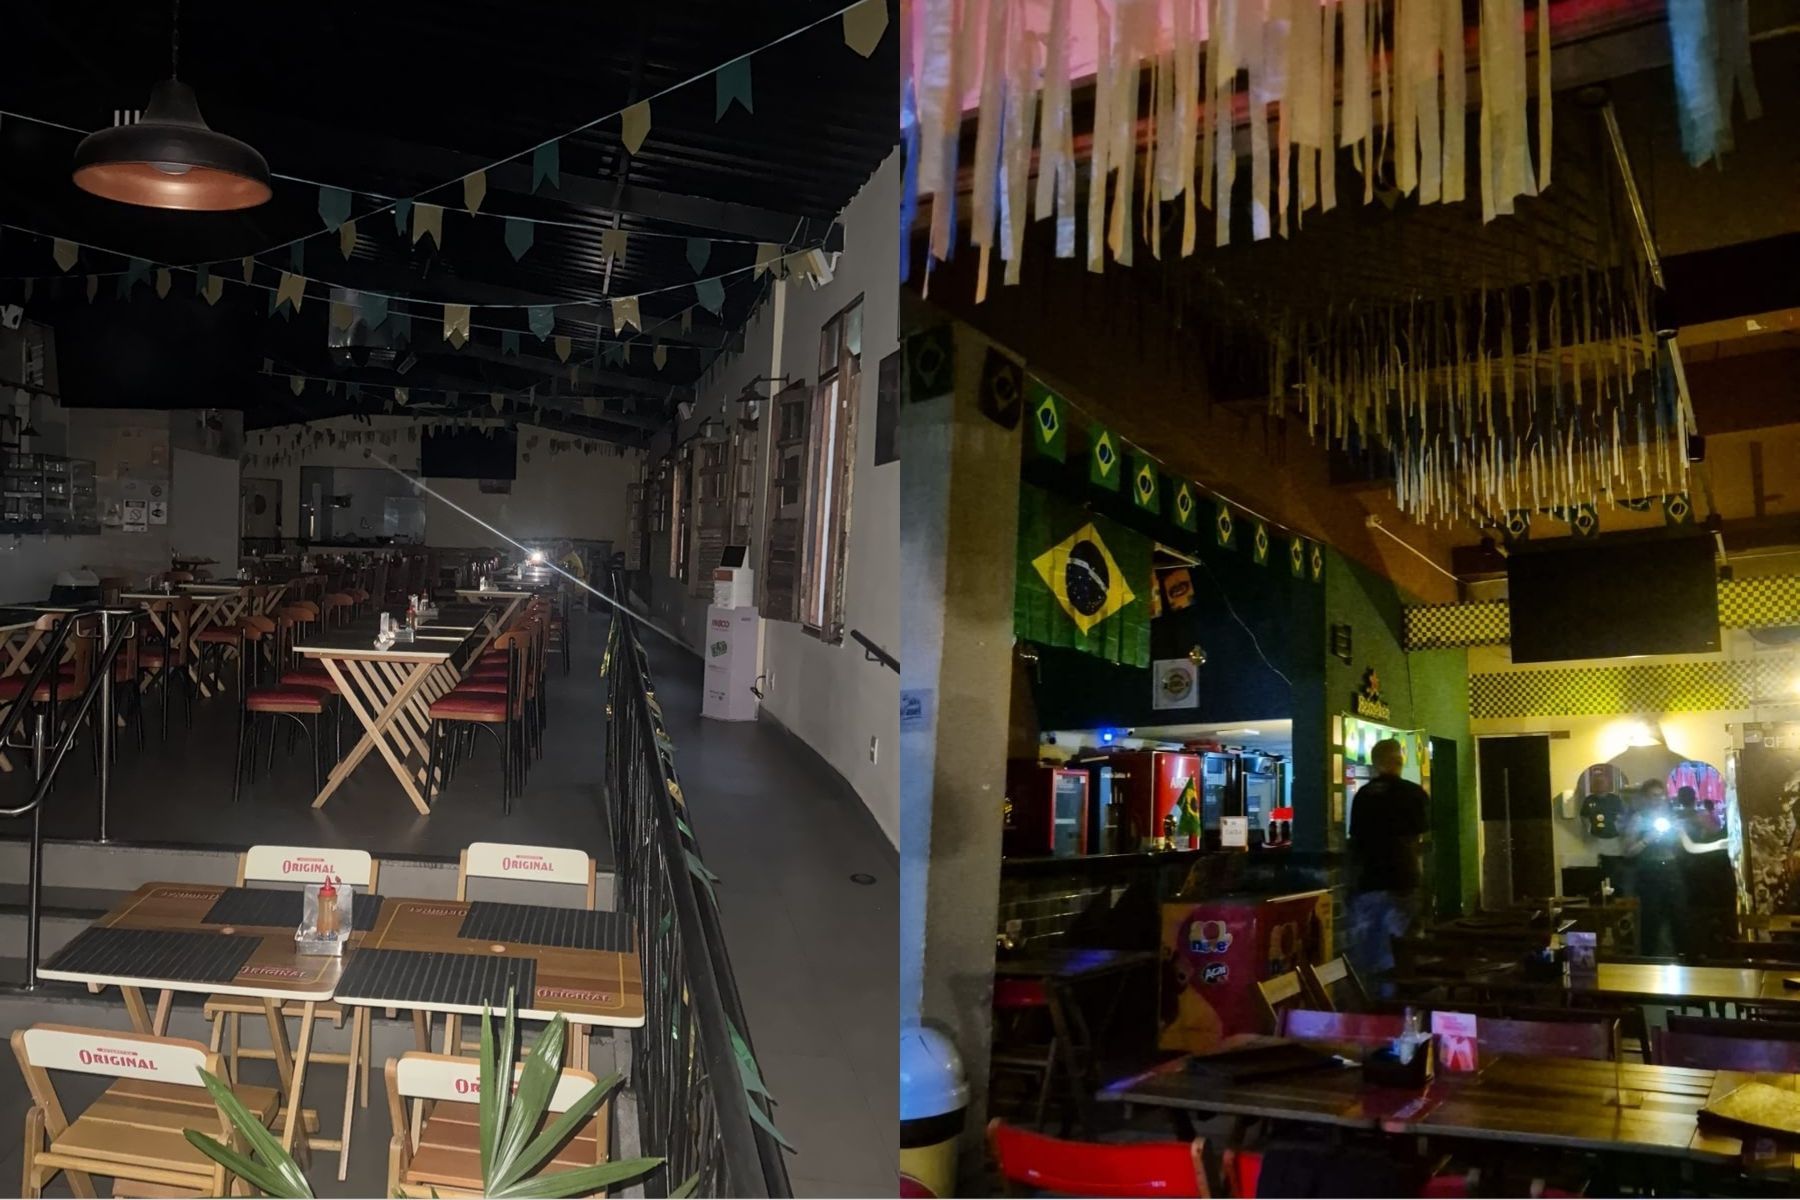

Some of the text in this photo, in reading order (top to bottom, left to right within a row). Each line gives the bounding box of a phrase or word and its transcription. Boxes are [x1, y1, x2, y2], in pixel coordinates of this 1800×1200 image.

[283, 860, 336, 874] ORIGINAL
[503, 857, 555, 871] ORIGINAL
[79, 1049, 159, 1070] ORIGINAL
